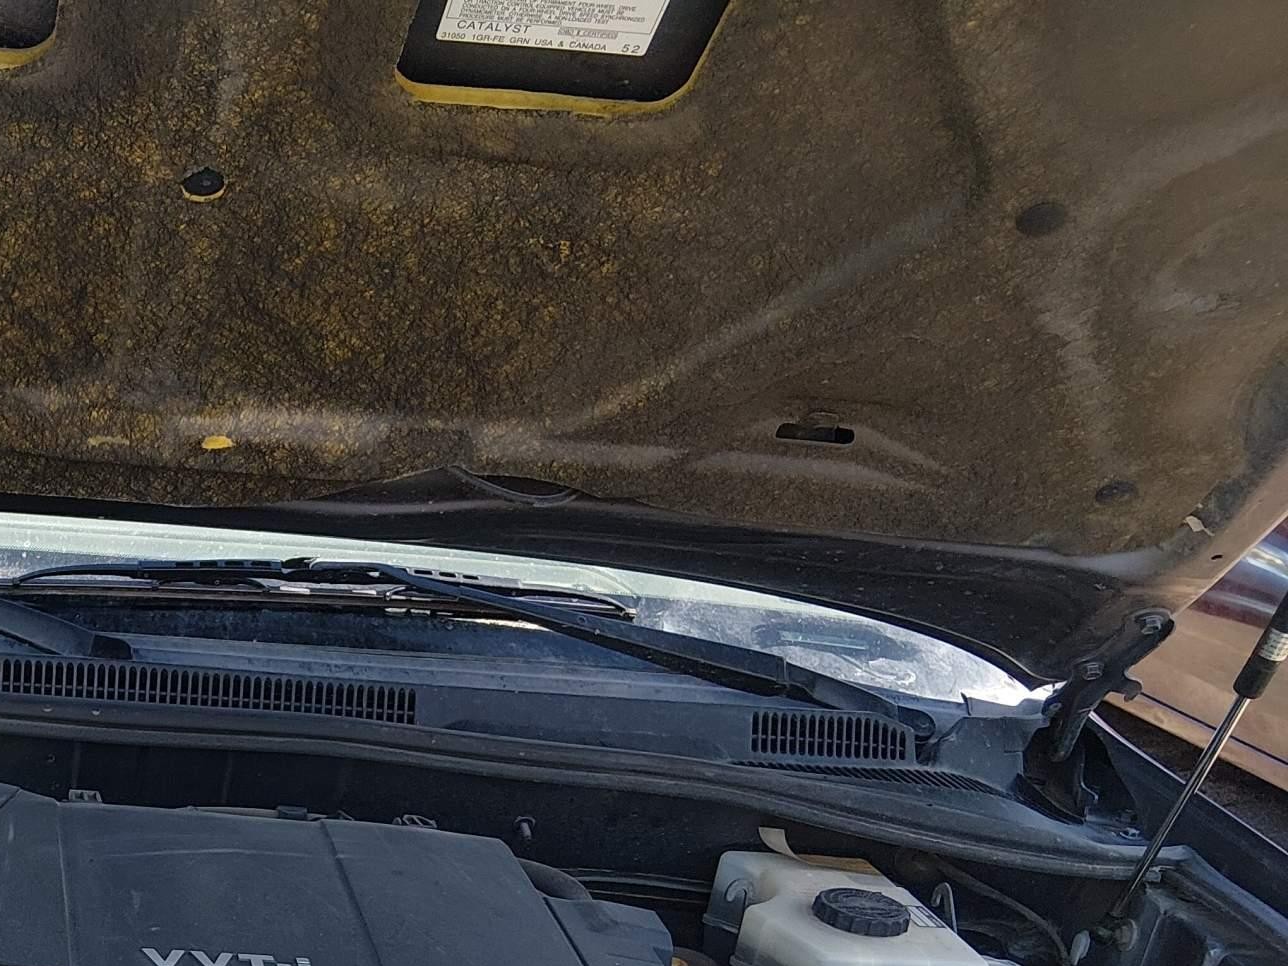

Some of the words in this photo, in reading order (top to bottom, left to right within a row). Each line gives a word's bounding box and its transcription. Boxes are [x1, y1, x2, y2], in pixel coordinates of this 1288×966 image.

[457, 20, 532, 34] CATALYST
[440, 31, 466, 40] 31050
[472, 34, 505, 43] 1GR-FE
[509, 36, 531, 45] GRN
[534, 38, 553, 47] USA
[569, 41, 607, 51] CANADA
